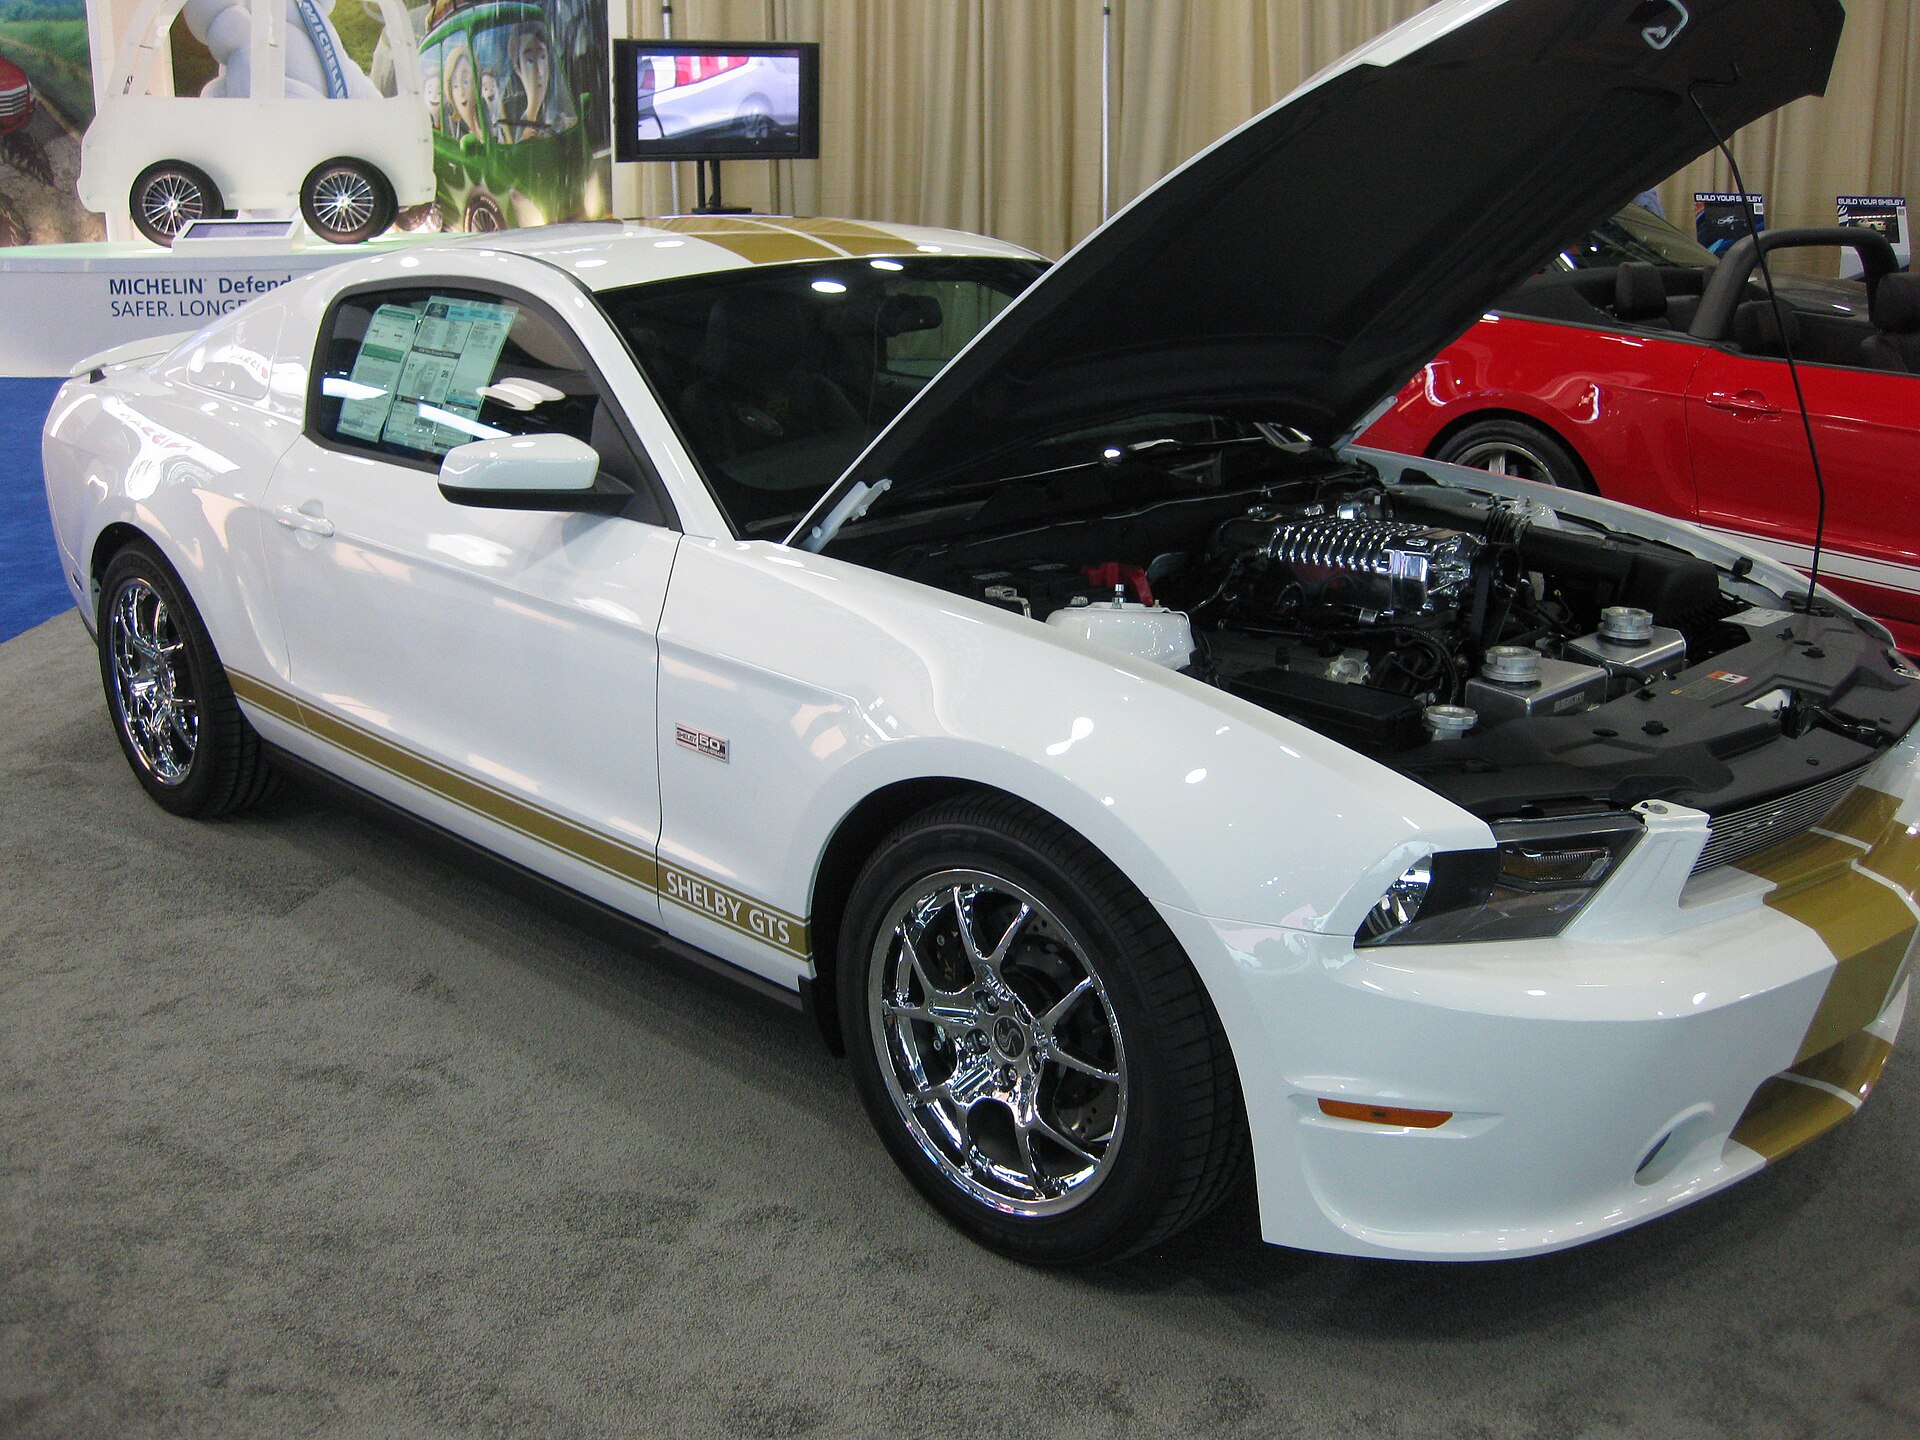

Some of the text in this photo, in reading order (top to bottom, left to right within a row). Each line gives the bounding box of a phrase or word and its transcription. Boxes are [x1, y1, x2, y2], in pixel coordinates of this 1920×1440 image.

[109, 278, 203, 295] MICHELIN
[111, 300, 174, 317] SAFER.
[666, 871, 790, 944] SHELBY GTS
